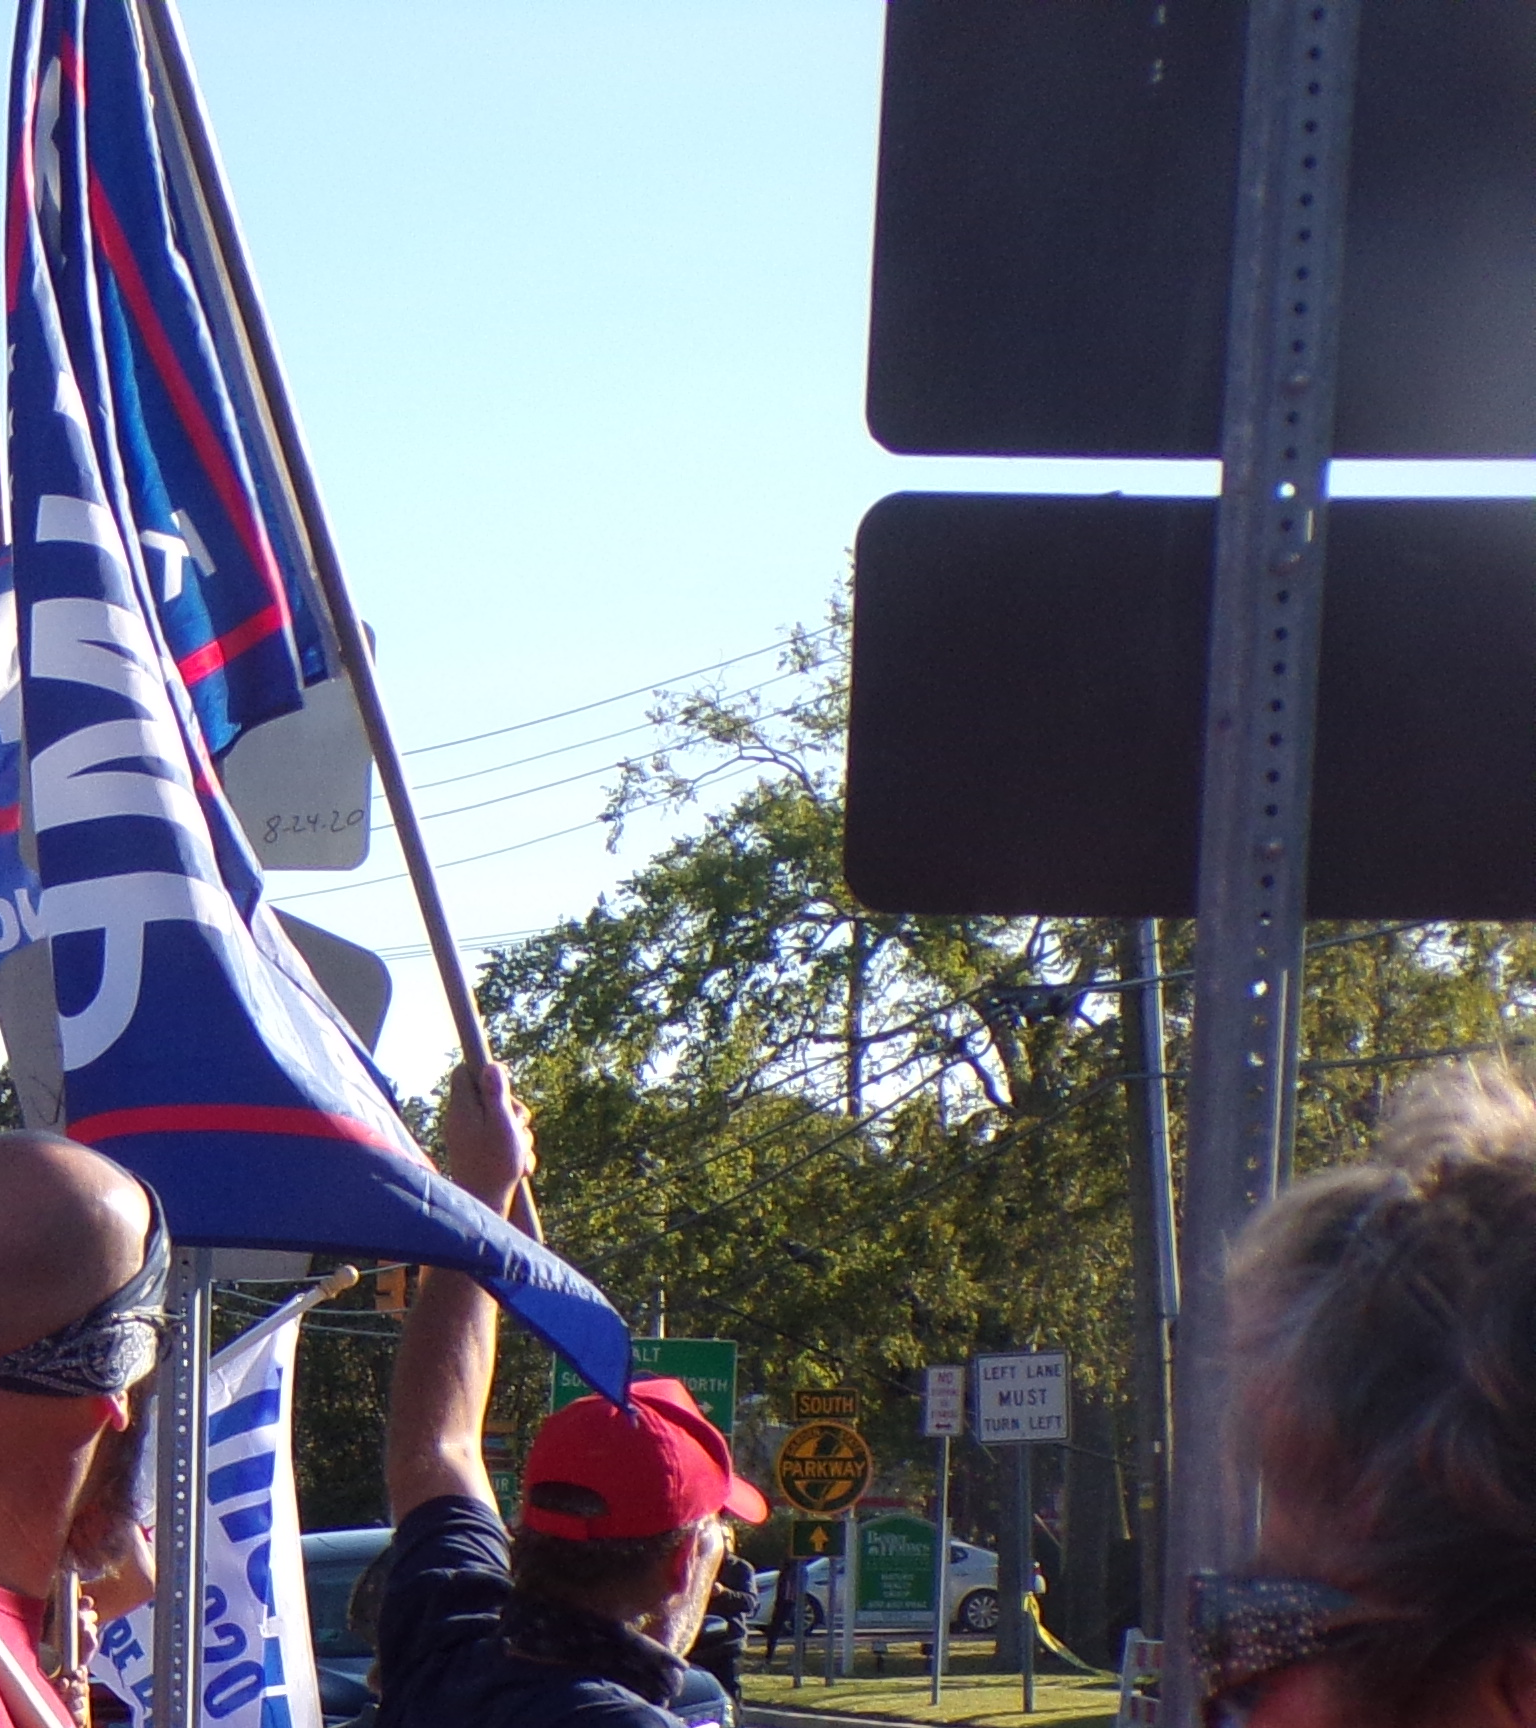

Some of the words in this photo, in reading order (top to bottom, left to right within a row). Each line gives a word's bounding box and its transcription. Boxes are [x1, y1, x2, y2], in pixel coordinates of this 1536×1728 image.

[983, 1365, 1016, 1381] LEFT
[1027, 1363, 1062, 1379] LANE
[799, 1395, 855, 1414] SOUTH
[998, 1388, 1047, 1407] MUST
[984, 1417, 1020, 1432] TURN
[1029, 1415, 1062, 1430] LEFT
[782, 1460, 866, 1478] PARKWAY
